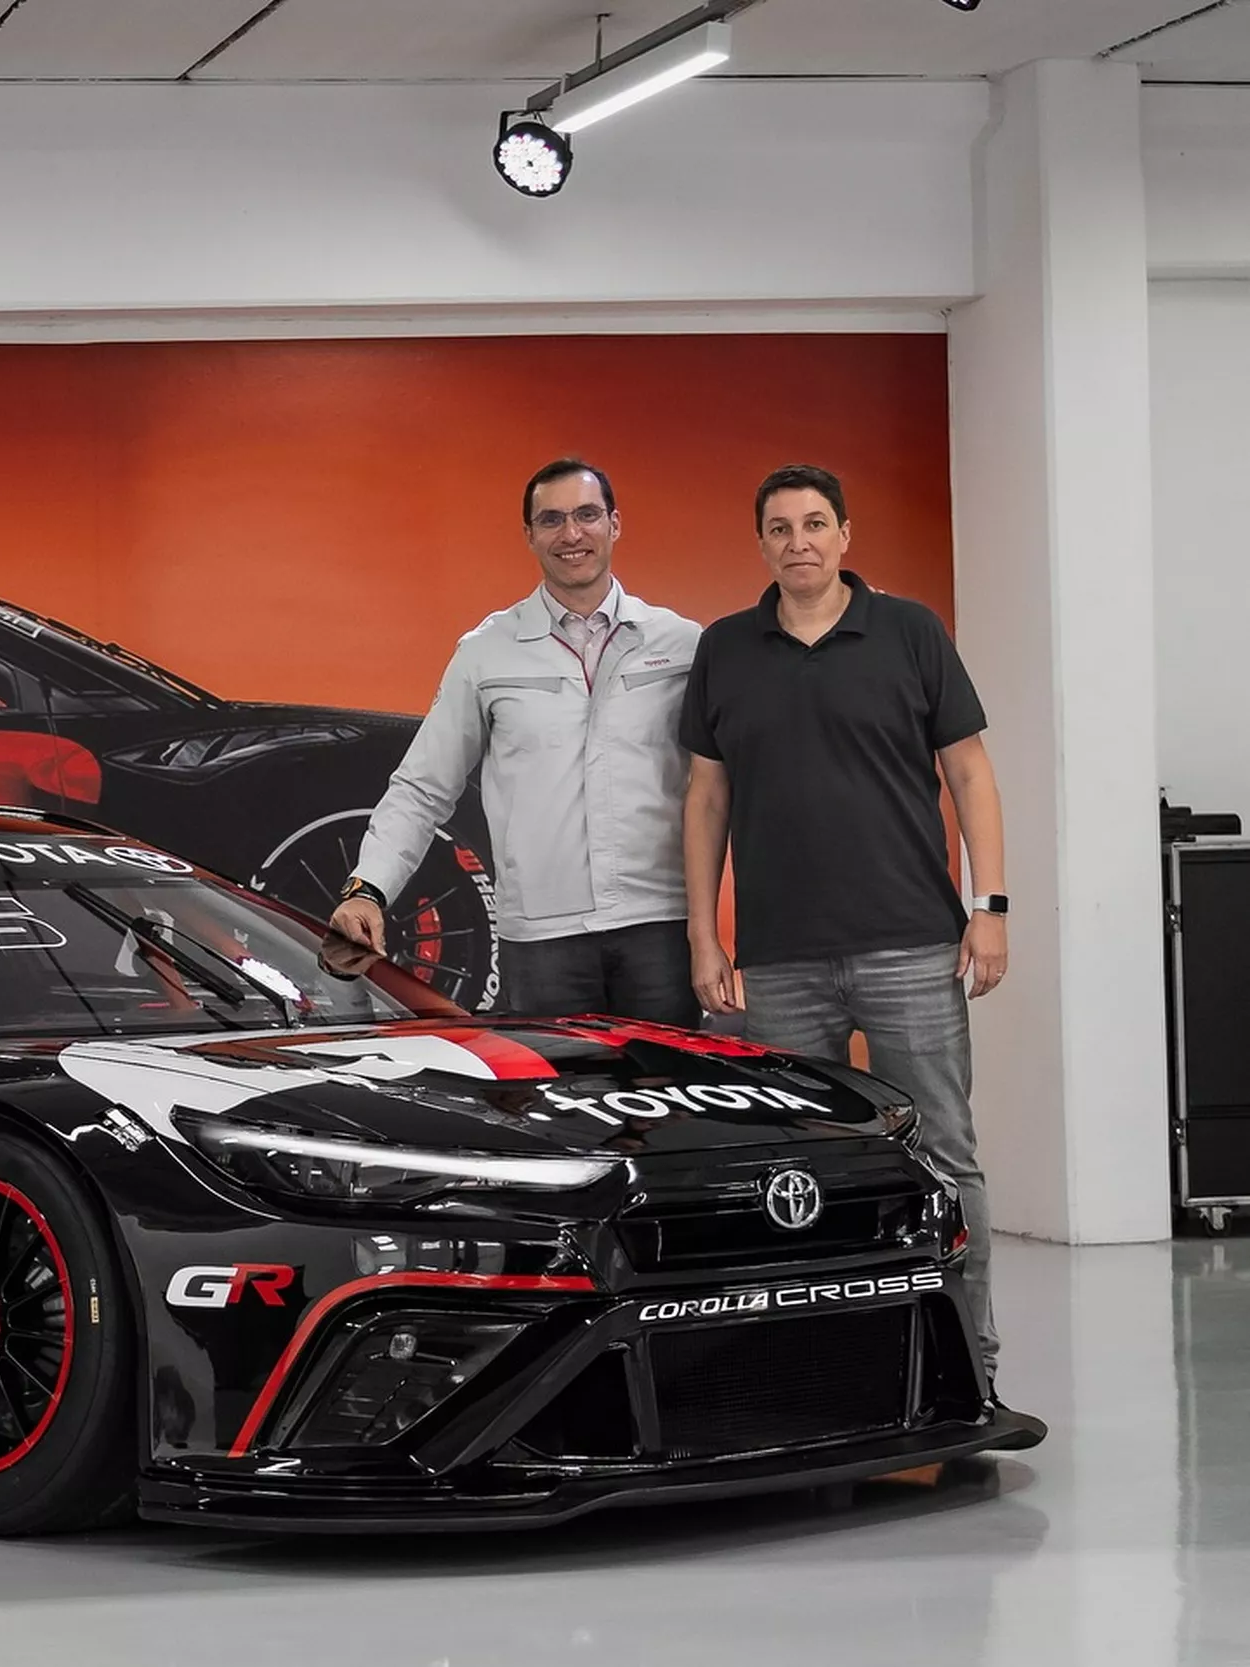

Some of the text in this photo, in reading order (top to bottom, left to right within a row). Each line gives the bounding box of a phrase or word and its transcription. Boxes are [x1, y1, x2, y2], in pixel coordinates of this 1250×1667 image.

[554, 1084, 833, 1126] TOYOTA
[166, 1263, 296, 1309] GR
[639, 1271, 944, 1321] COROLLA CROSS
